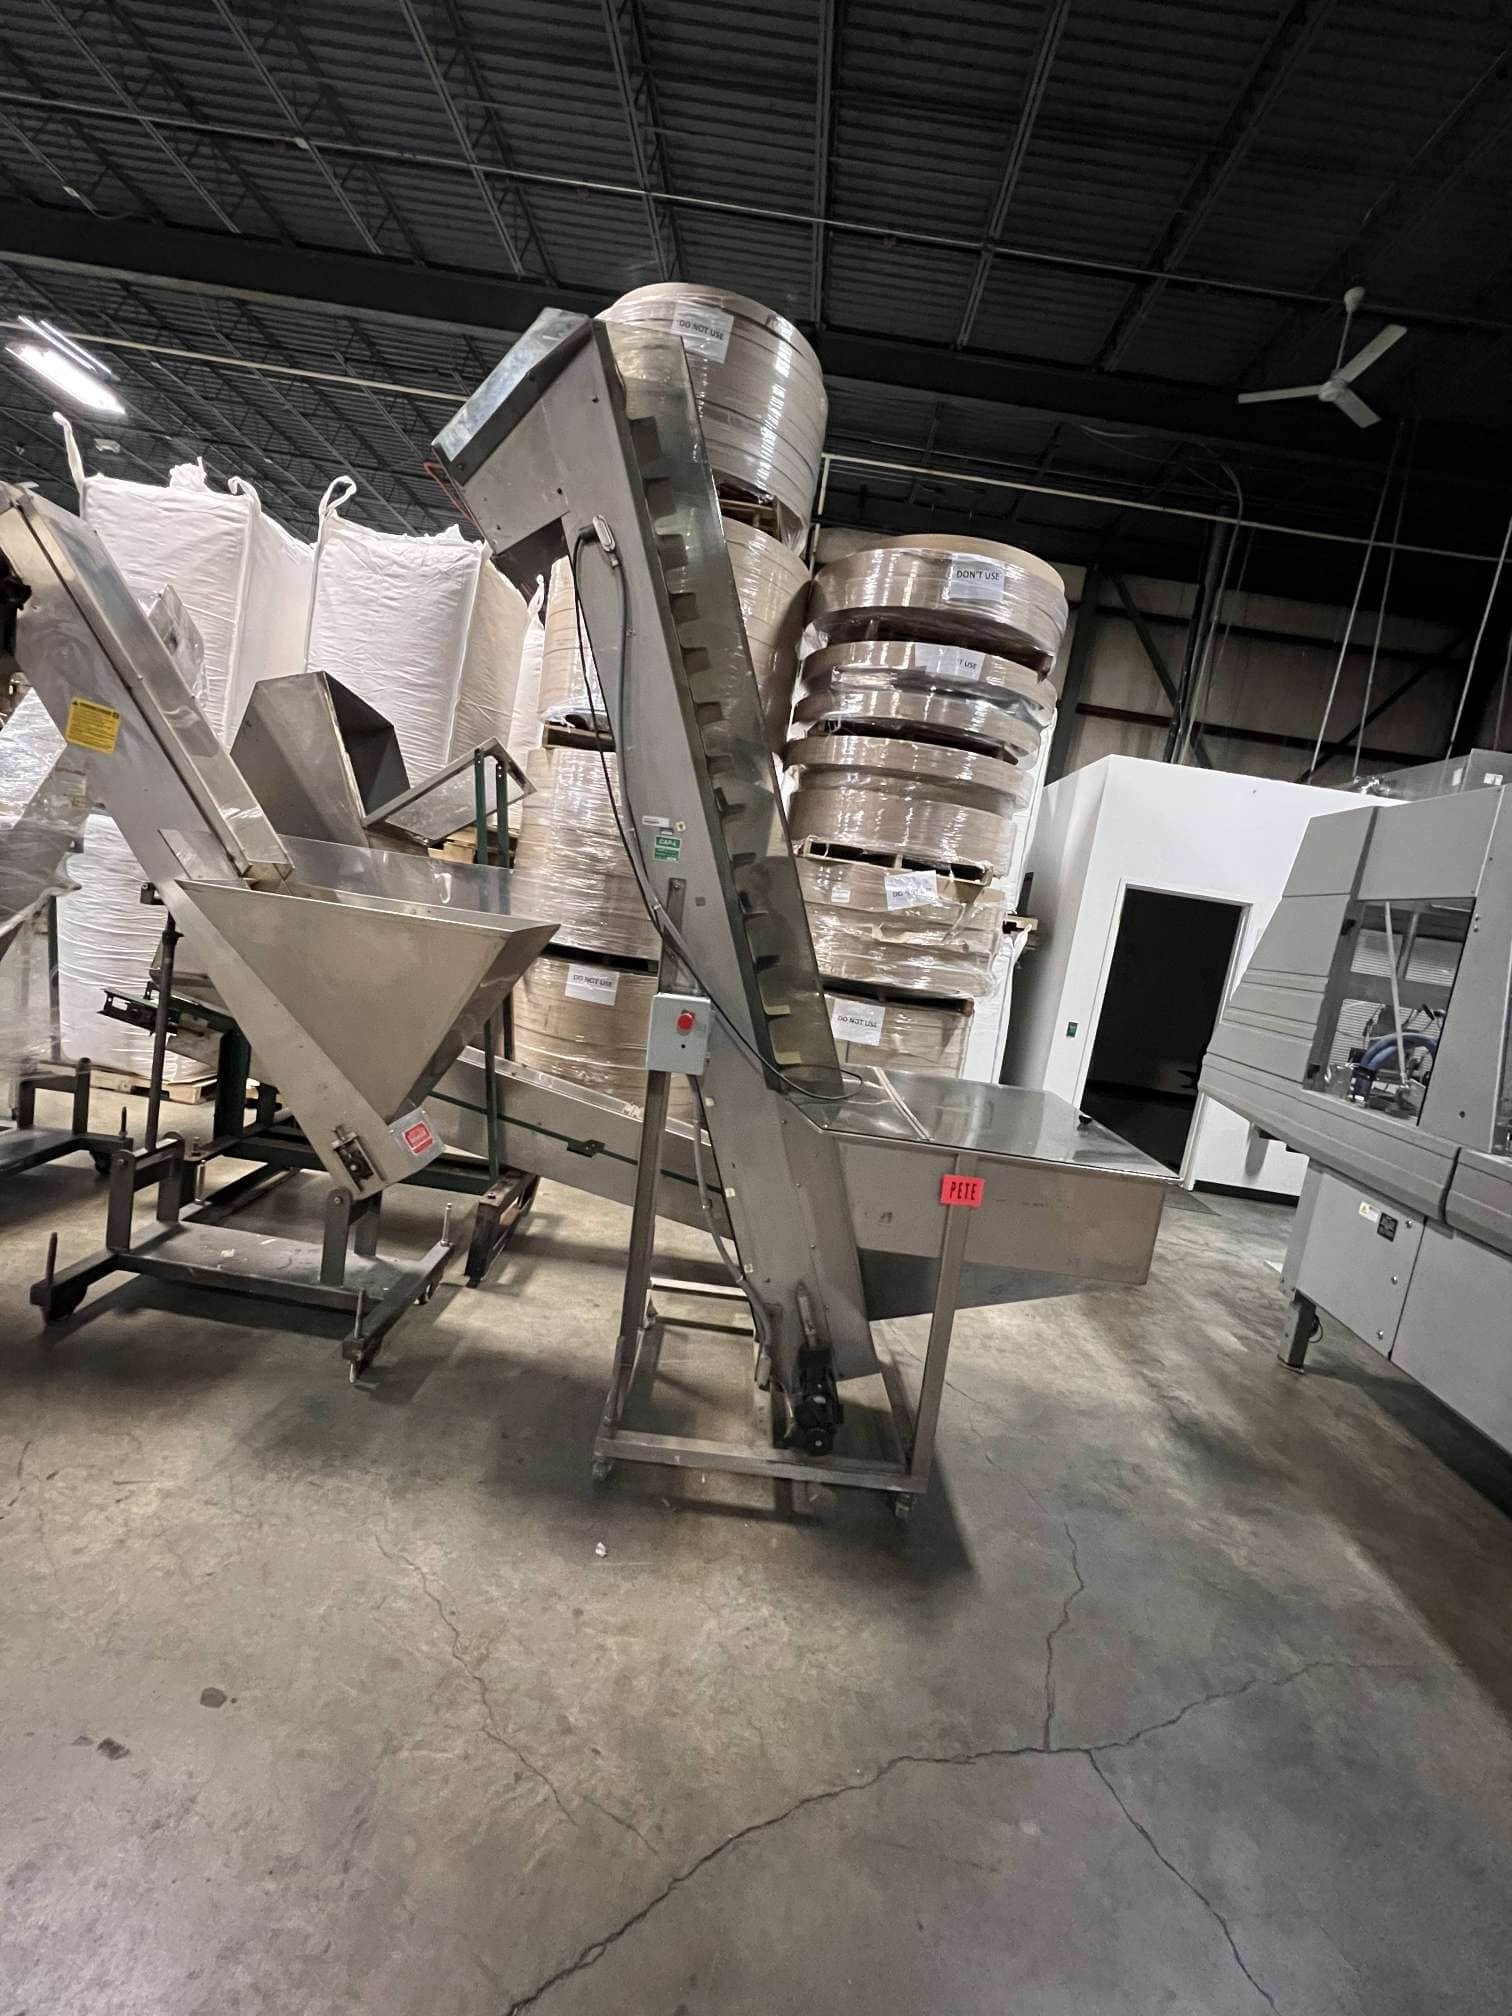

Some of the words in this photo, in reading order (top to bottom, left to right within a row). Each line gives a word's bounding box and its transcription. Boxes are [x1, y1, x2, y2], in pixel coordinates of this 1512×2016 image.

[679, 320, 691, 328] DO
[711, 329, 724, 340] USE
[956, 570, 982, 579] DON'T
[985, 572, 999, 581] USE
[949, 1181, 977, 1201] PETE
